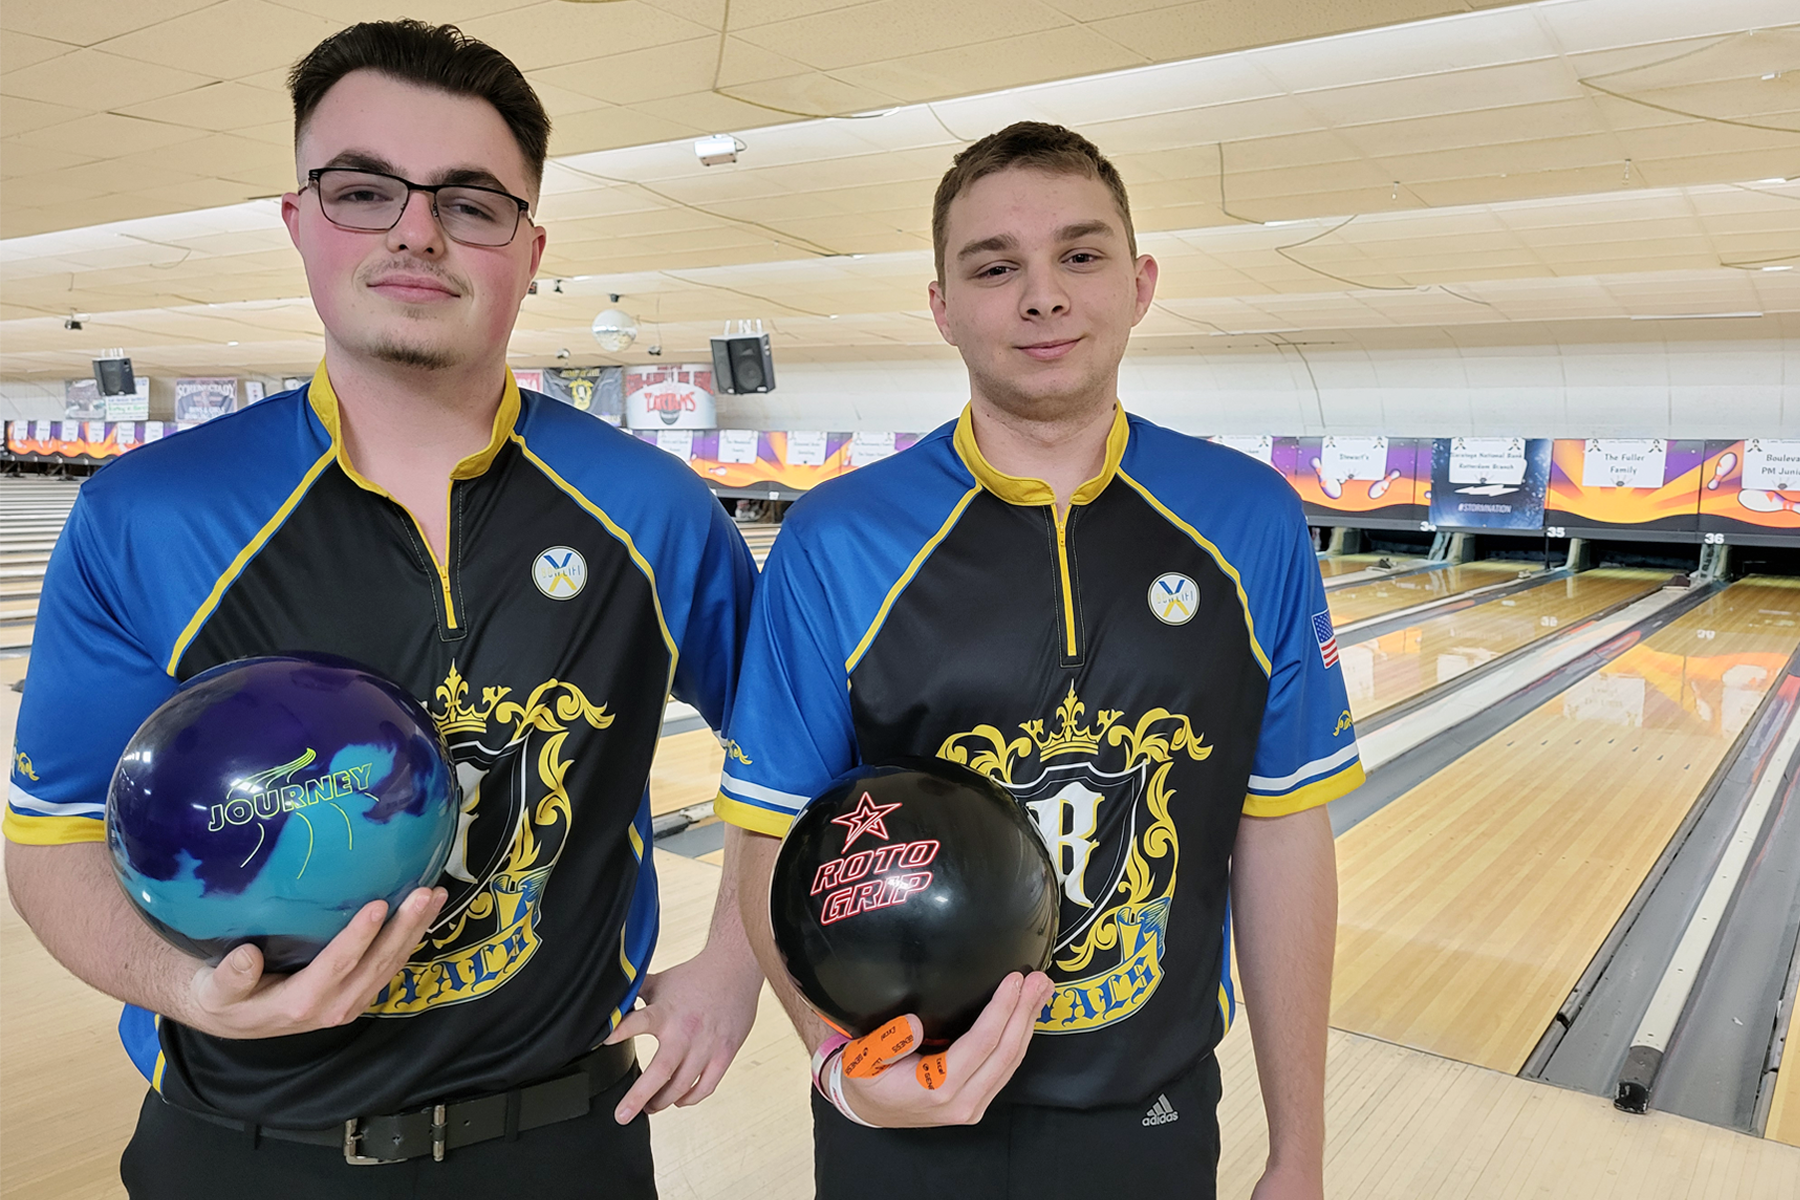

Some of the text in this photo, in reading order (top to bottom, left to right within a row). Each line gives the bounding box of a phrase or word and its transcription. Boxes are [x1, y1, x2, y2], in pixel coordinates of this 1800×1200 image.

[1339, 453, 1370, 461] Stewart's
[1605, 453, 1645, 461] The Fuller
[1610, 465, 1637, 475] Family
[1761, 466, 1776, 475] PM
[1547, 526, 1566, 538] 35
[1704, 533, 1725, 545] 36
[208, 763, 373, 832] JOURNEY
[810, 839, 941, 897] ROTO
[820, 871, 934, 927] GRIP
[1141, 1110, 1179, 1127] adidas
